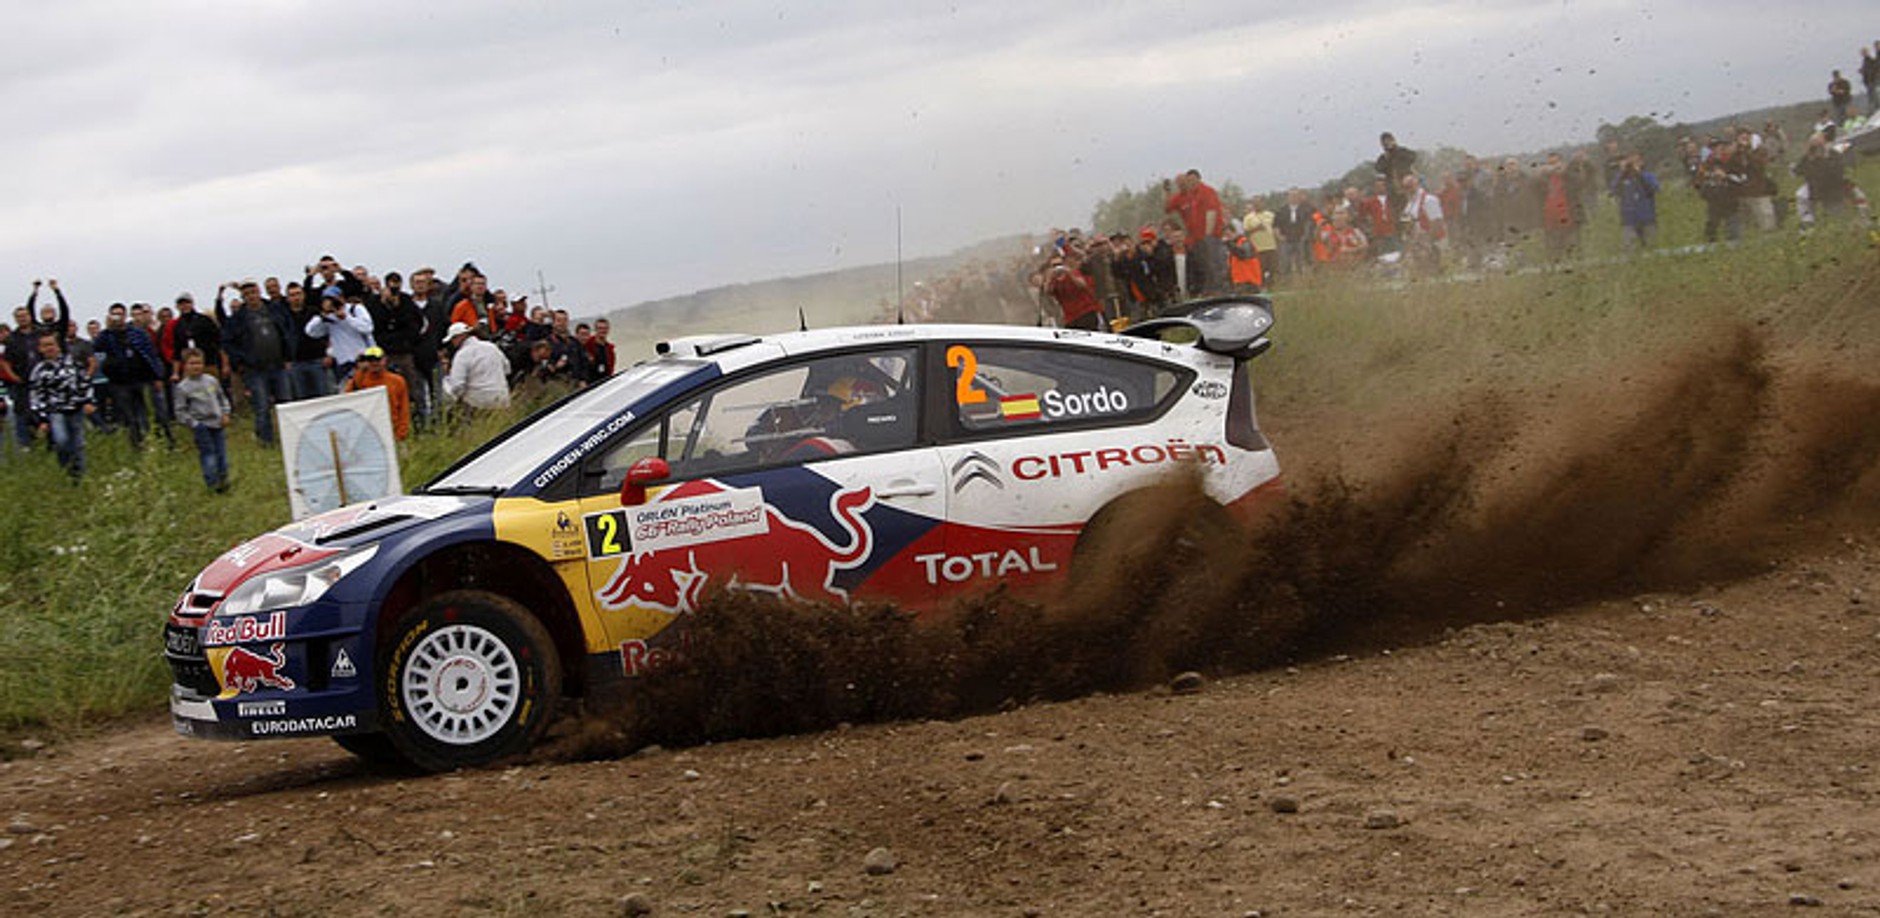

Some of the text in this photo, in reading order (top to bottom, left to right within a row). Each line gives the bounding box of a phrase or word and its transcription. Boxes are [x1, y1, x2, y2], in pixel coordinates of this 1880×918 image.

[946, 344, 988, 404] 2
[1043, 386, 1128, 416] Sordo
[636, 501, 732, 524] ORLEN Platinum
[667, 517, 704, 536] Rally
[704, 507, 763, 530] Poland
[597, 513, 621, 555] 2
[914, 546, 1057, 584] TOTAL
[206, 611, 287, 645] Red Bull
[387, 619, 429, 722] SCORPION
[251, 714, 357, 735] EURODATACAR
